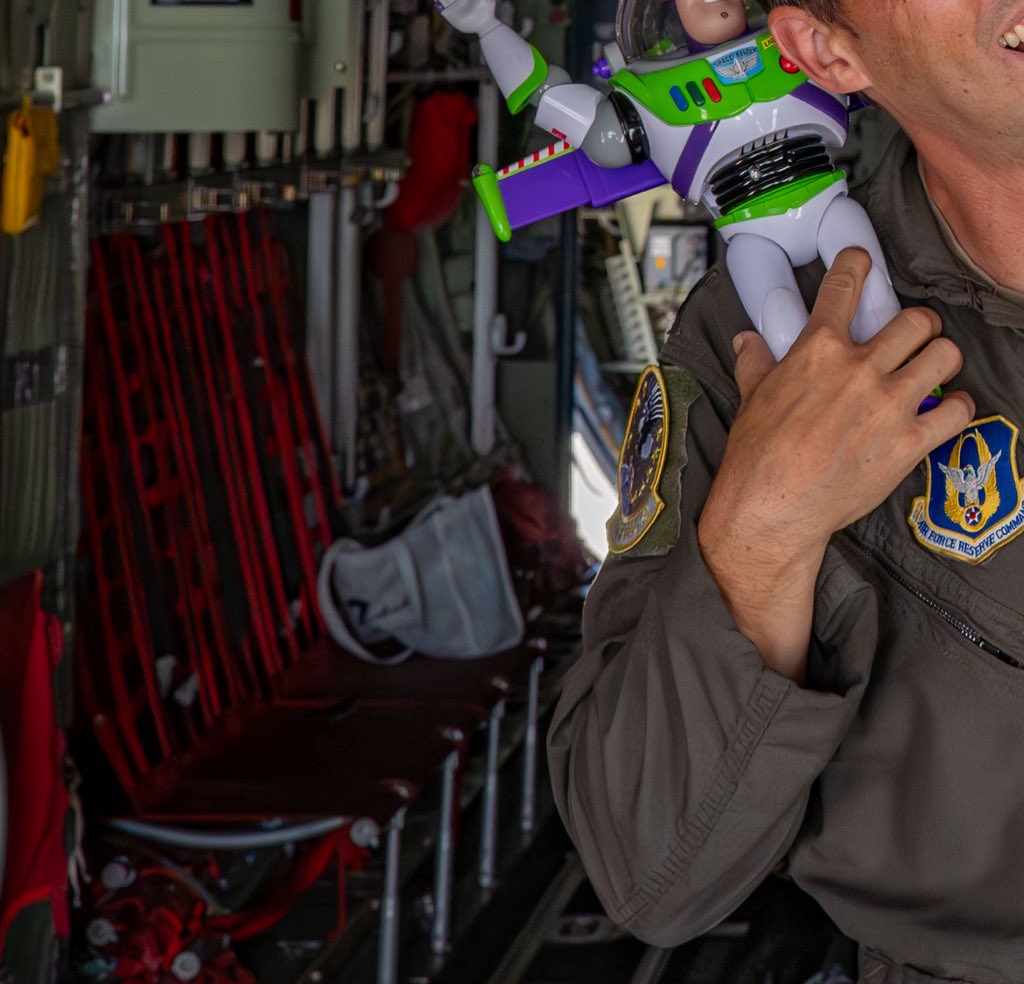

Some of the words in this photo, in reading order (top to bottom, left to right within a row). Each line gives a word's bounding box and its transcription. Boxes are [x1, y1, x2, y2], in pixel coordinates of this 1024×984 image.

[713, 55, 734, 66] SPACE
[916, 520, 928, 538] AIR
[928, 532, 956, 548] FORCE
[958, 535, 995, 558] RESERVE
